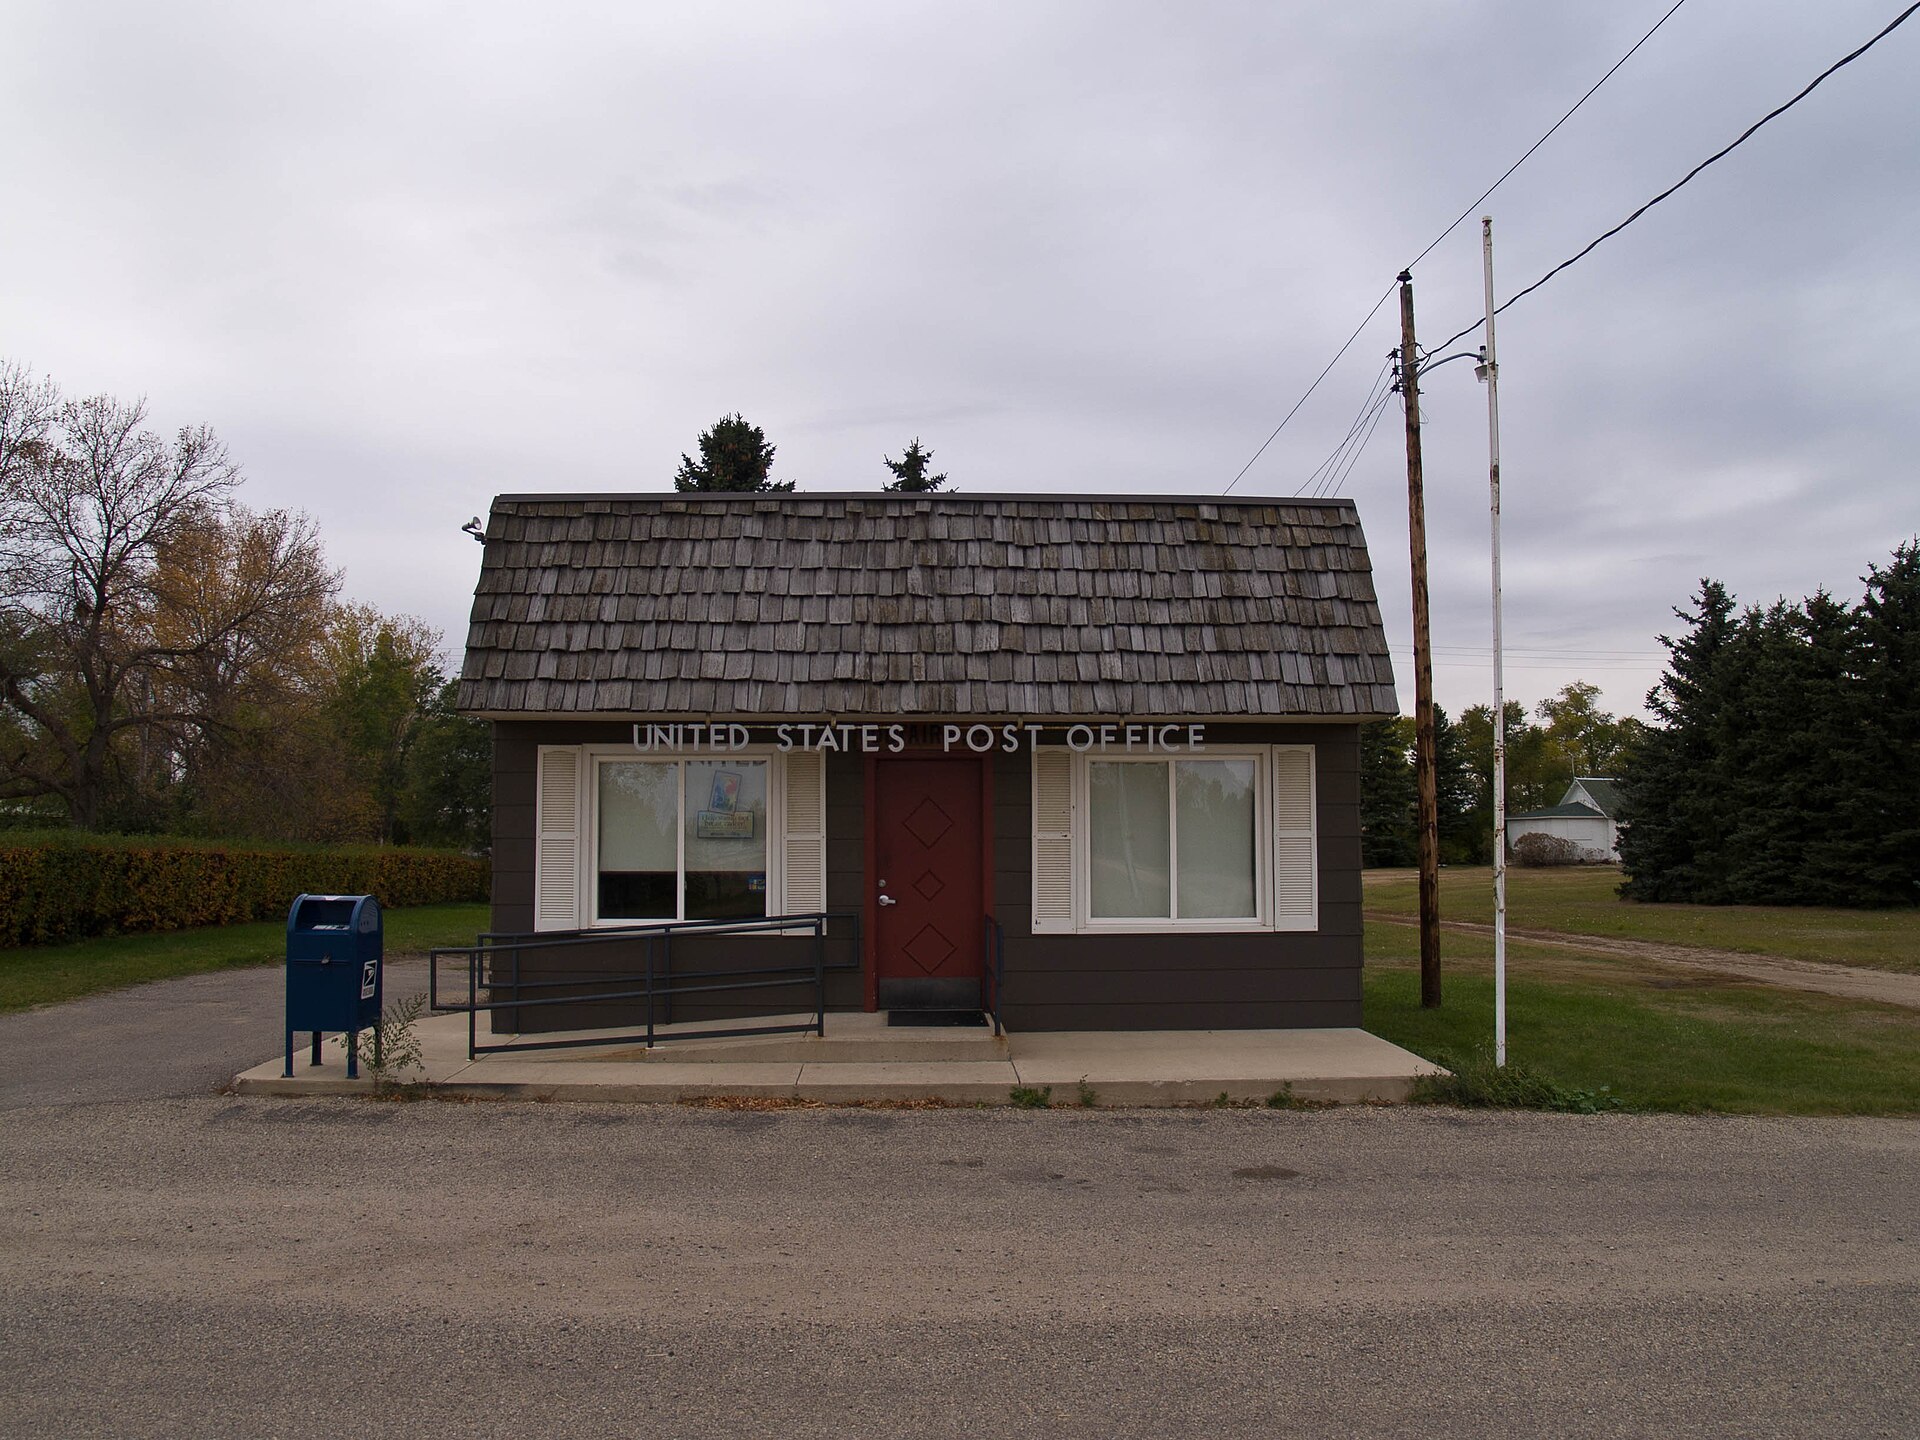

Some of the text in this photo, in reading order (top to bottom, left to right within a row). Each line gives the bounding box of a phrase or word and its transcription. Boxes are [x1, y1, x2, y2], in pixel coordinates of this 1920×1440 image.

[632, 724, 750, 752] UNITED
[776, 724, 905, 753] STATES
[943, 724, 1043, 753] POST
[1066, 724, 1205, 752] OFFICE
